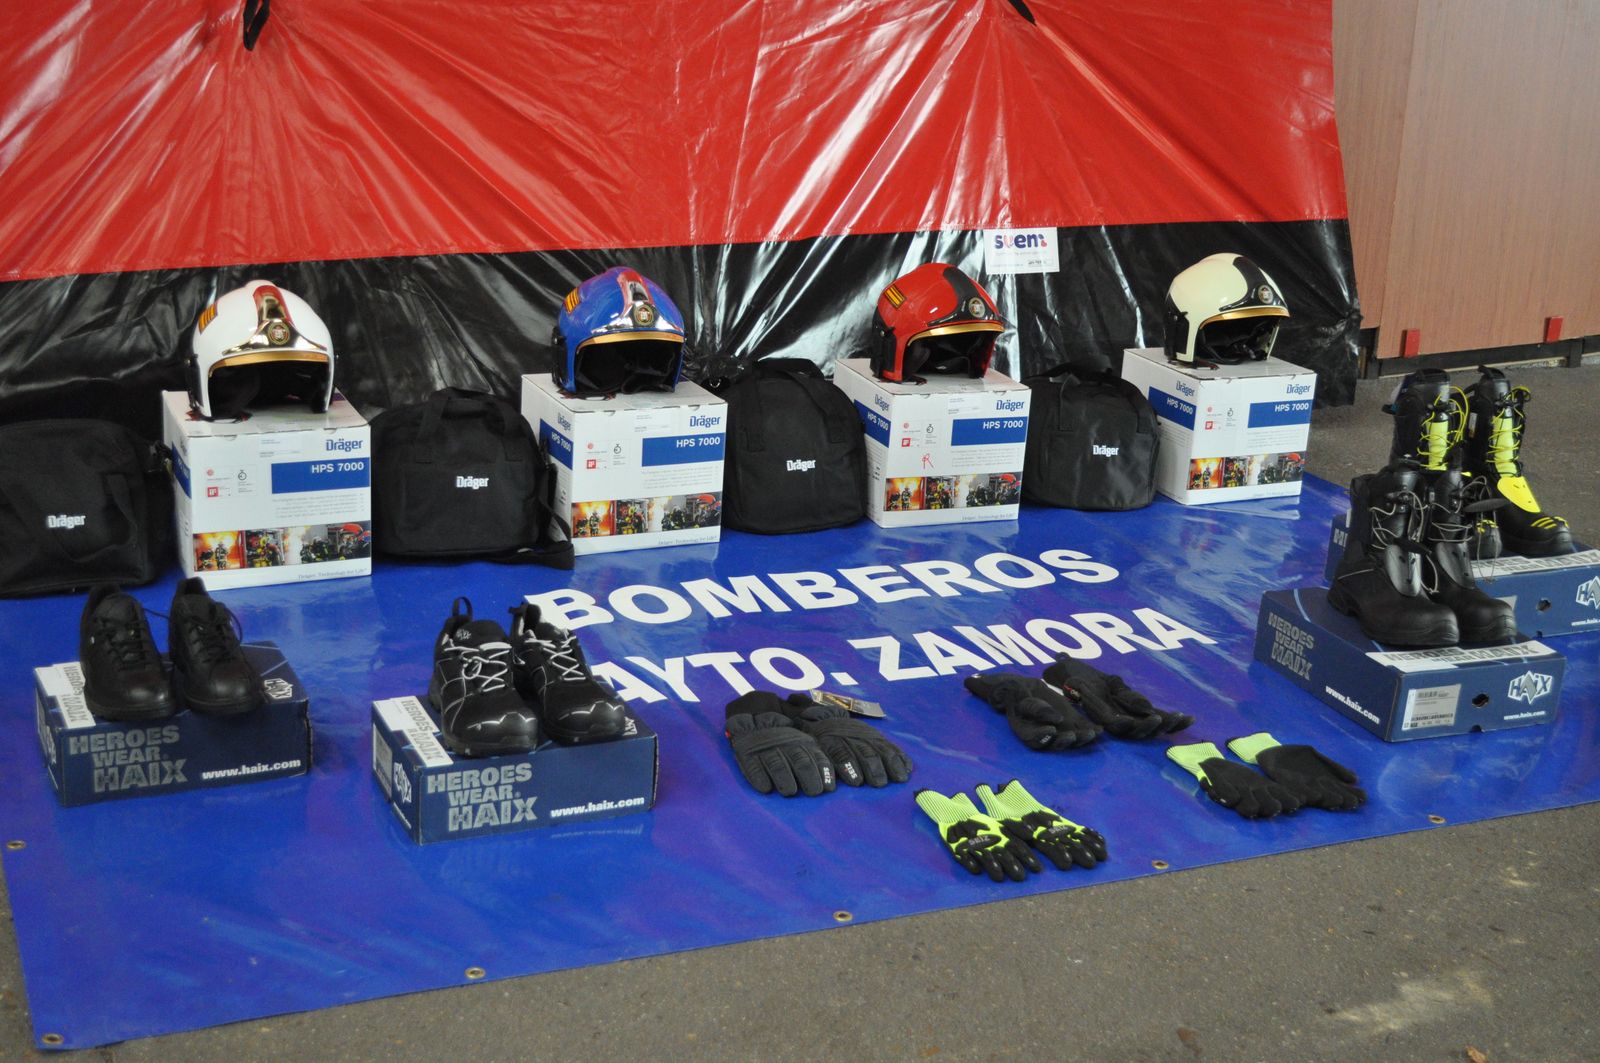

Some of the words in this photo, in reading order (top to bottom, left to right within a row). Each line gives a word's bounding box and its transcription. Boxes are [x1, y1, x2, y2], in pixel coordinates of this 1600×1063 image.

[1286, 383, 1312, 395] Dräger
[996, 399, 1025, 412] Dräger
[1274, 404, 1290, 413] HPS
[1291, 402, 1309, 412] 7000
[689, 415, 721, 428] Dräger
[982, 420, 1001, 430] HPS
[1002, 419, 1024, 429] 7000
[326, 438, 364, 453] Dräger
[676, 438, 696, 449] HPS
[698, 436, 721, 447] 7000
[1093, 444, 1120, 457] Dräger
[311, 462, 335, 475] HPS
[337, 461, 365, 473] 7000
[786, 459, 816, 472] Dräger
[456, 475, 490, 490] Dräger
[47, 514, 86, 529] Dräger
[525, 551, 1121, 630] BOMBEROS
[1268, 611, 1315, 649] HEROES
[588, 646, 859, 704] AYTO.
[854, 606, 1217, 684] ZAMORA
[1274, 633, 1303, 658] WEAR
[1383, 647, 1464, 661] HEROES
[1271, 642, 1314, 681] HAIX
[1325, 686, 1380, 725] www.haix.com
[400, 699, 433, 732] HEROES
[69, 725, 180, 755] HEROES
[93, 747, 161, 767] WEAR
[93, 759, 188, 792] HAIX
[202, 758, 301, 780] www.haix.com
[427, 763, 533, 794] HEROES
[823, 766, 832, 784] SEIZ
[844, 761, 858, 780] SEIZ
[448, 784, 513, 805] WEAR
[447, 796, 538, 832] HAIX
[550, 797, 645, 819] www.haix.com
